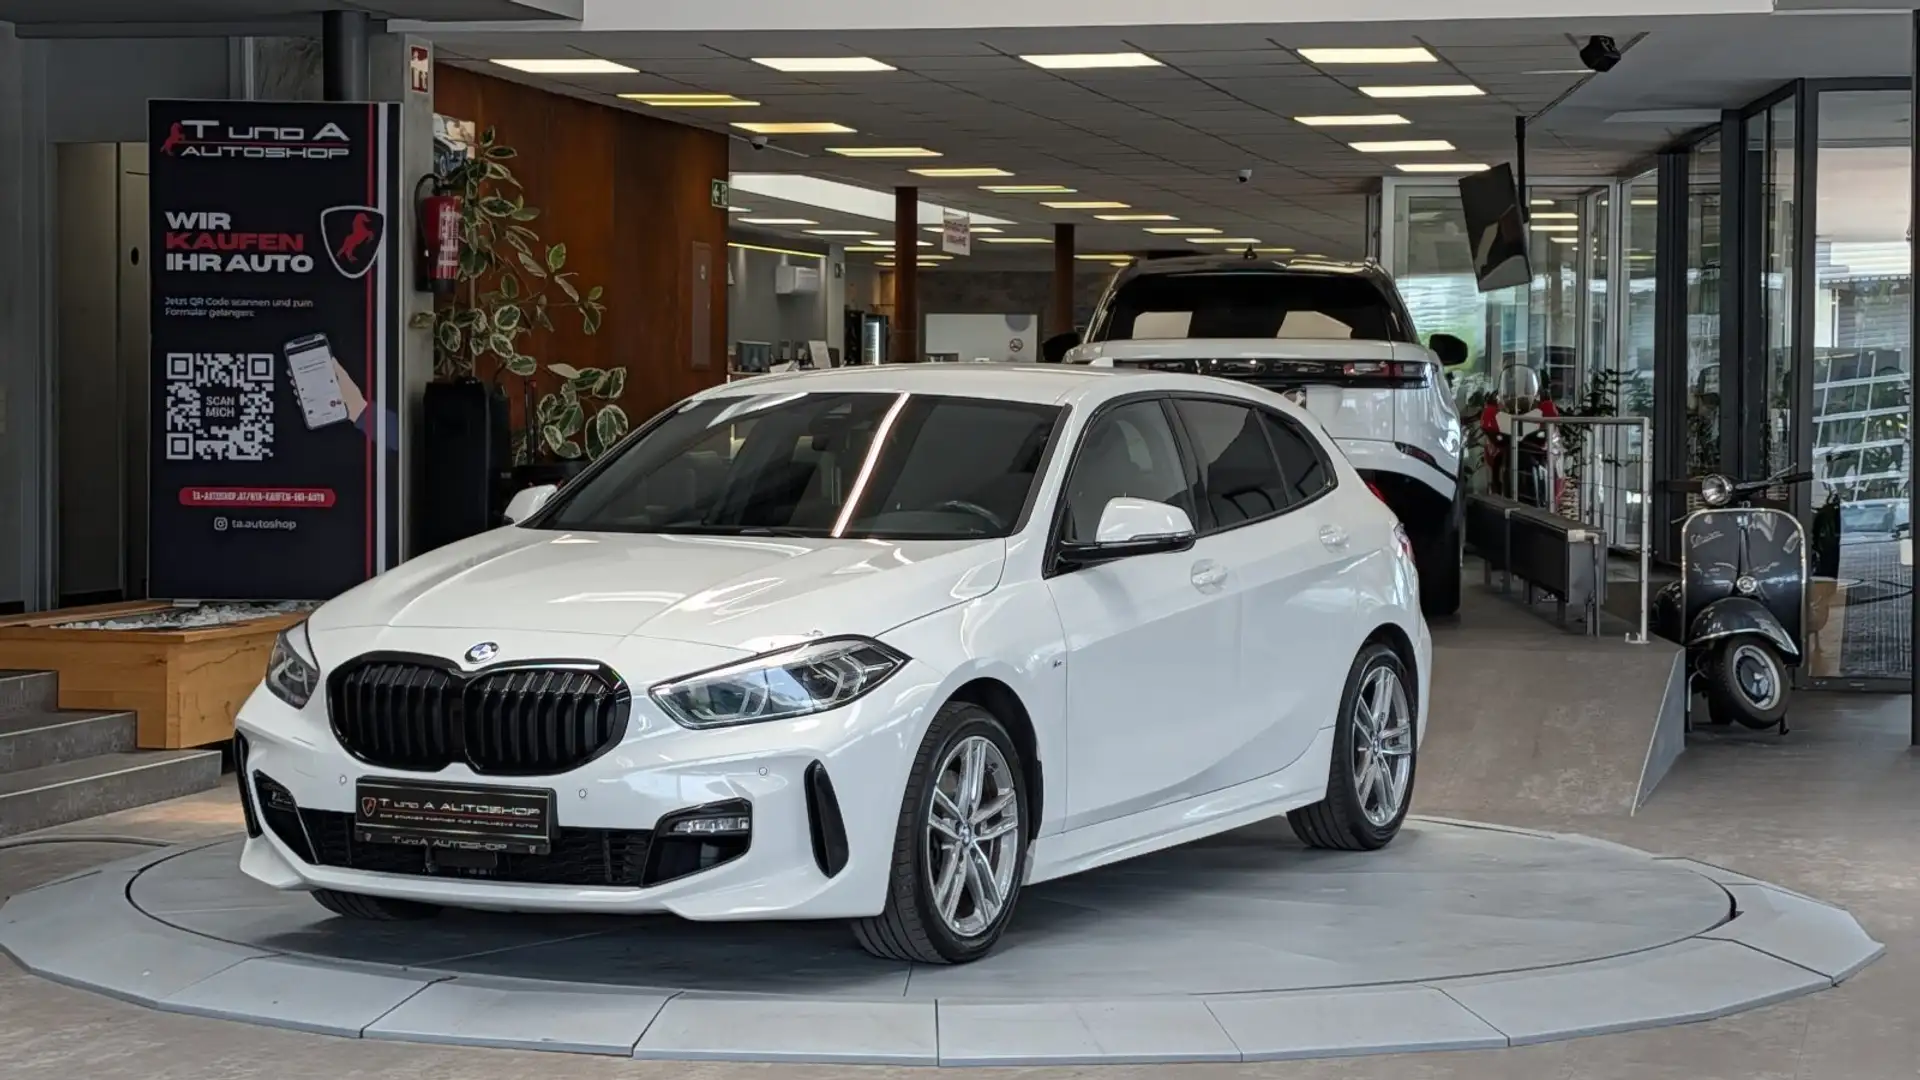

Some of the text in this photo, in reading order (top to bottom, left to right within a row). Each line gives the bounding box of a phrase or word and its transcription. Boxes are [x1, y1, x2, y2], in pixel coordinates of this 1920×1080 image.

[181, 120, 220, 139] T
[312, 122, 350, 141] A
[180, 146, 350, 159] AUTOSHOP
[165, 211, 231, 230] WIR
[166, 231, 304, 252] KAUFEN
[166, 253, 314, 273] IHR AUTO
[189, 297, 204, 307] QR
[205, 297, 230, 306] Code
[272, 298, 290, 307] und
[292, 300, 313, 308] zum
[206, 395, 235, 406] SCAN
[205, 406, 235, 418] MICH
[231, 518, 297, 531] ta.autoshop
[378, 798, 390, 807] T
[423, 801, 435, 810] A
[440, 802, 540, 816] AUTOSHOP
